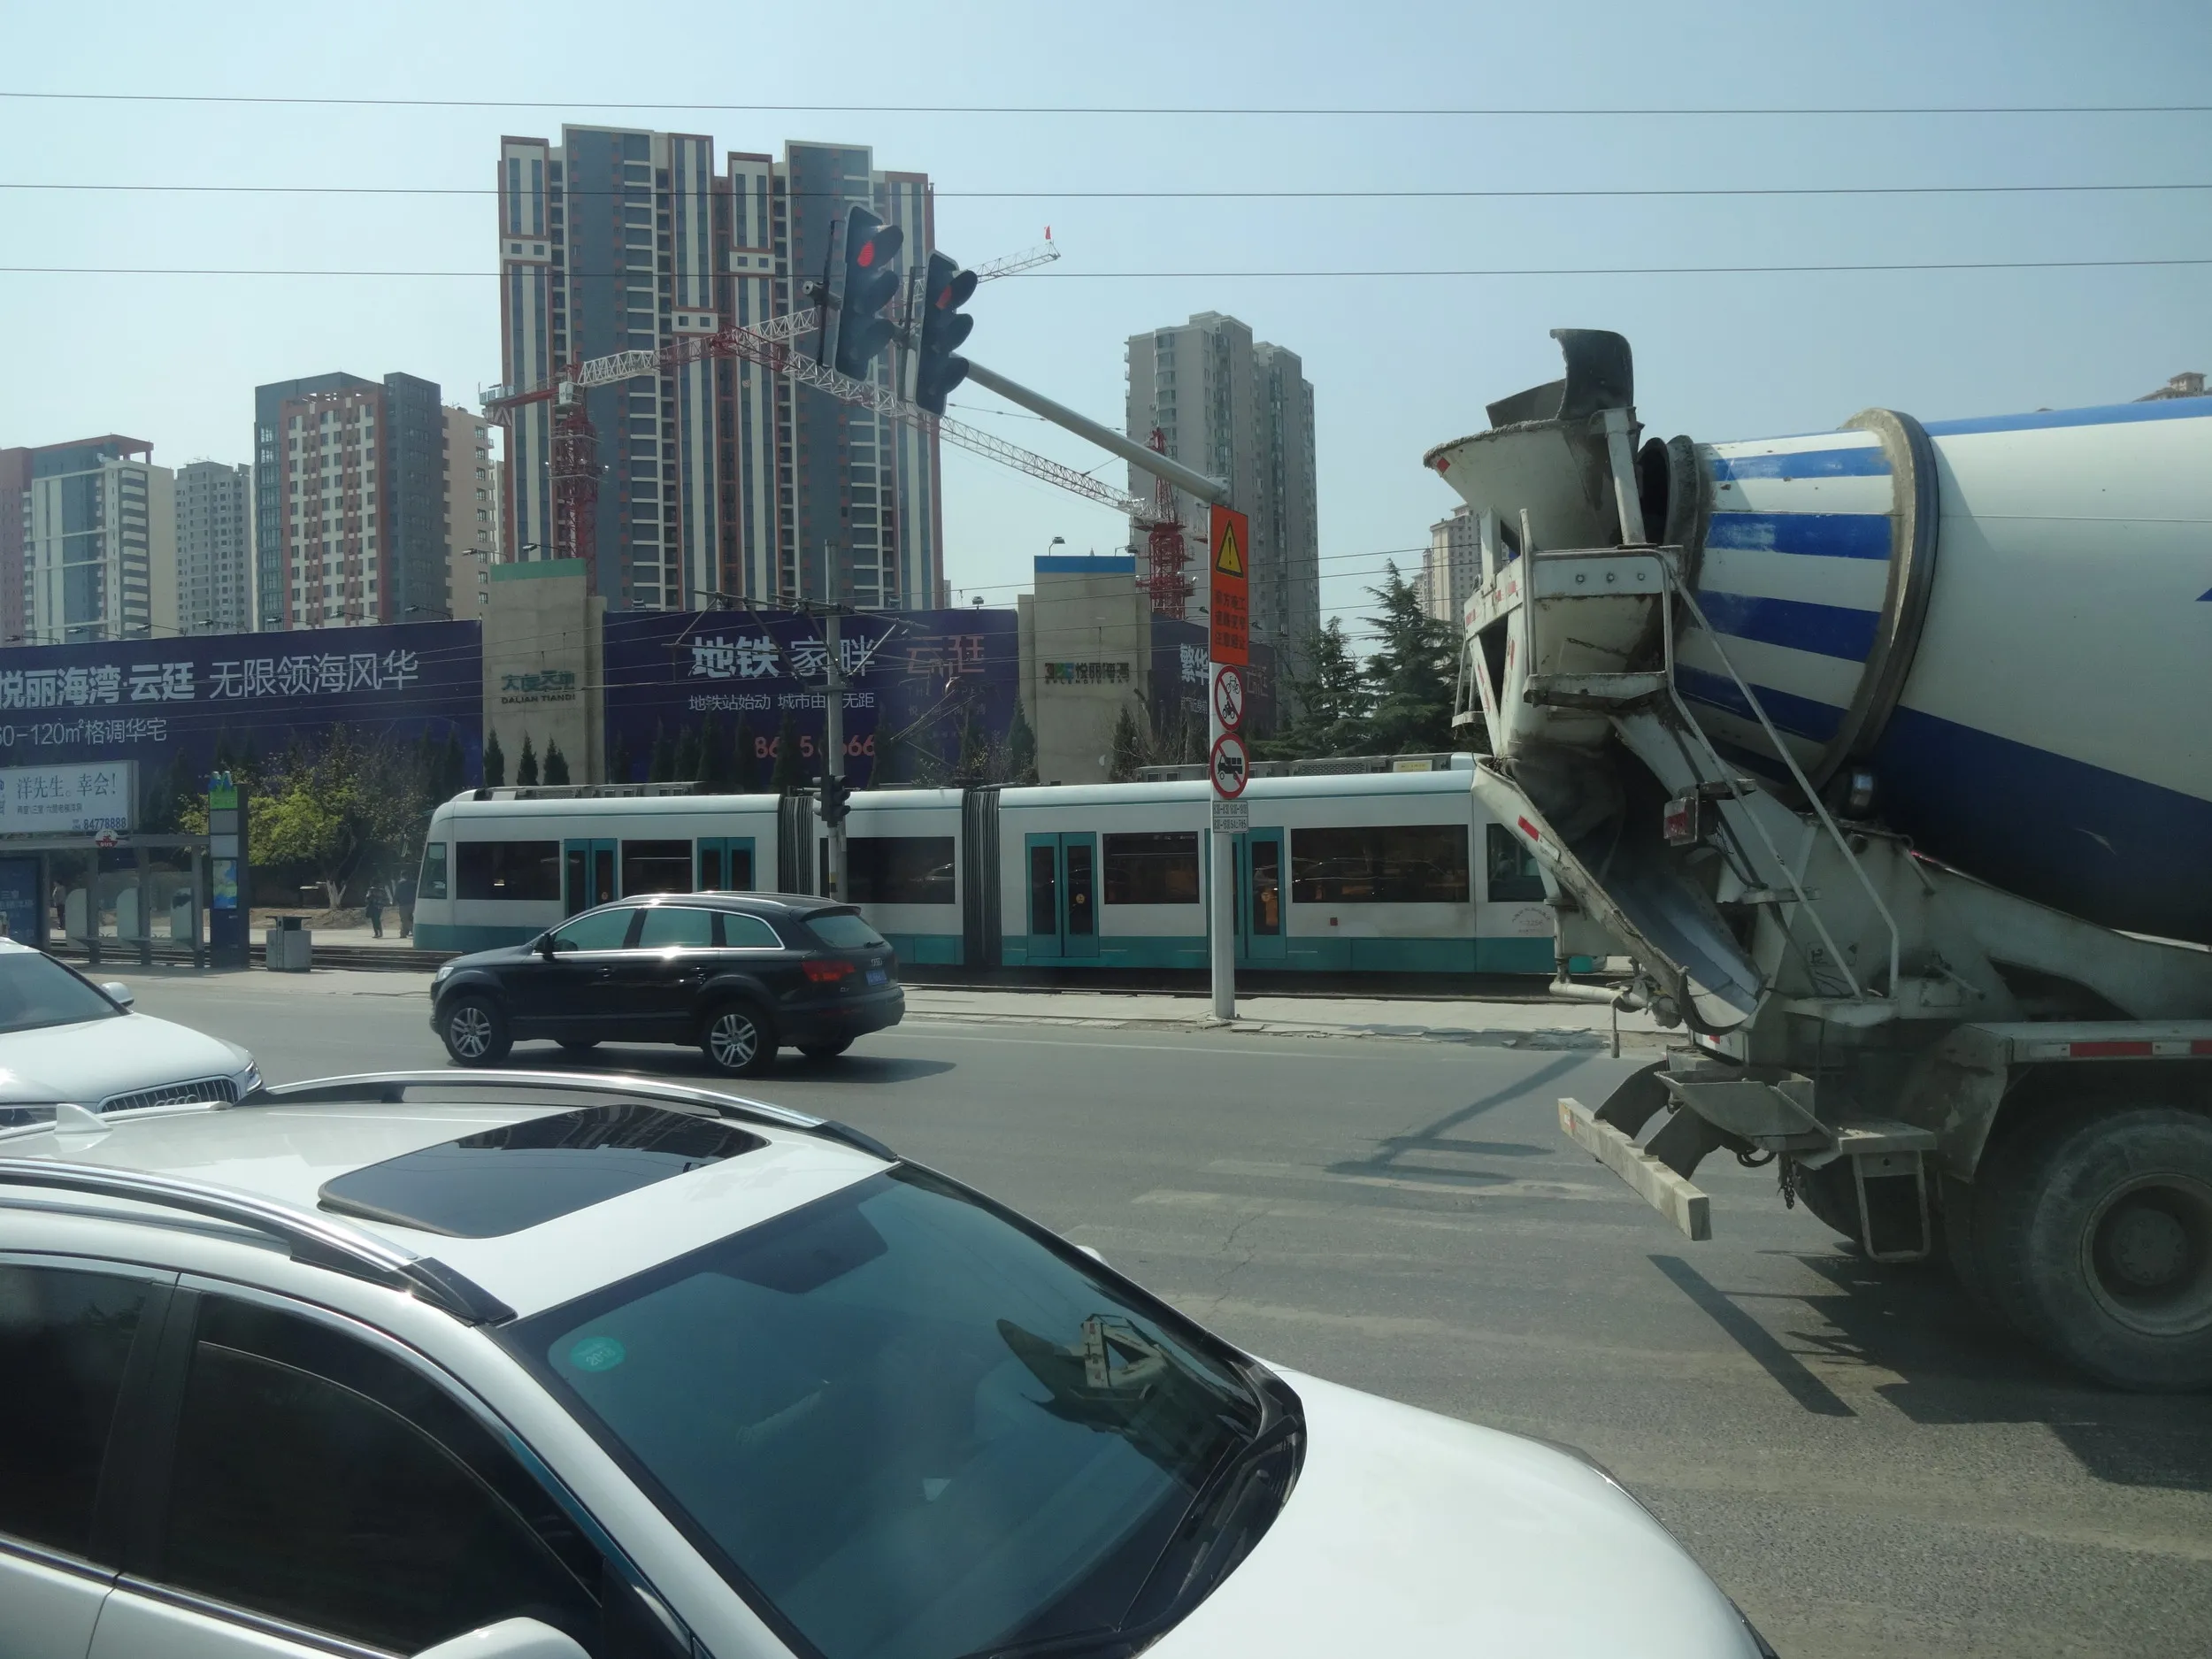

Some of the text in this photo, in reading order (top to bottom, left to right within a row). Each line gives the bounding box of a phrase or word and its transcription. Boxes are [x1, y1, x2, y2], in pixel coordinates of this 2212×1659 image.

[688, 635, 780, 679] 地铁
[209, 649, 419, 699] 无限领海风华
[688, 692, 875, 710] 地铁站始动 城市由无距
[83, 817, 127, 830] 84778888
